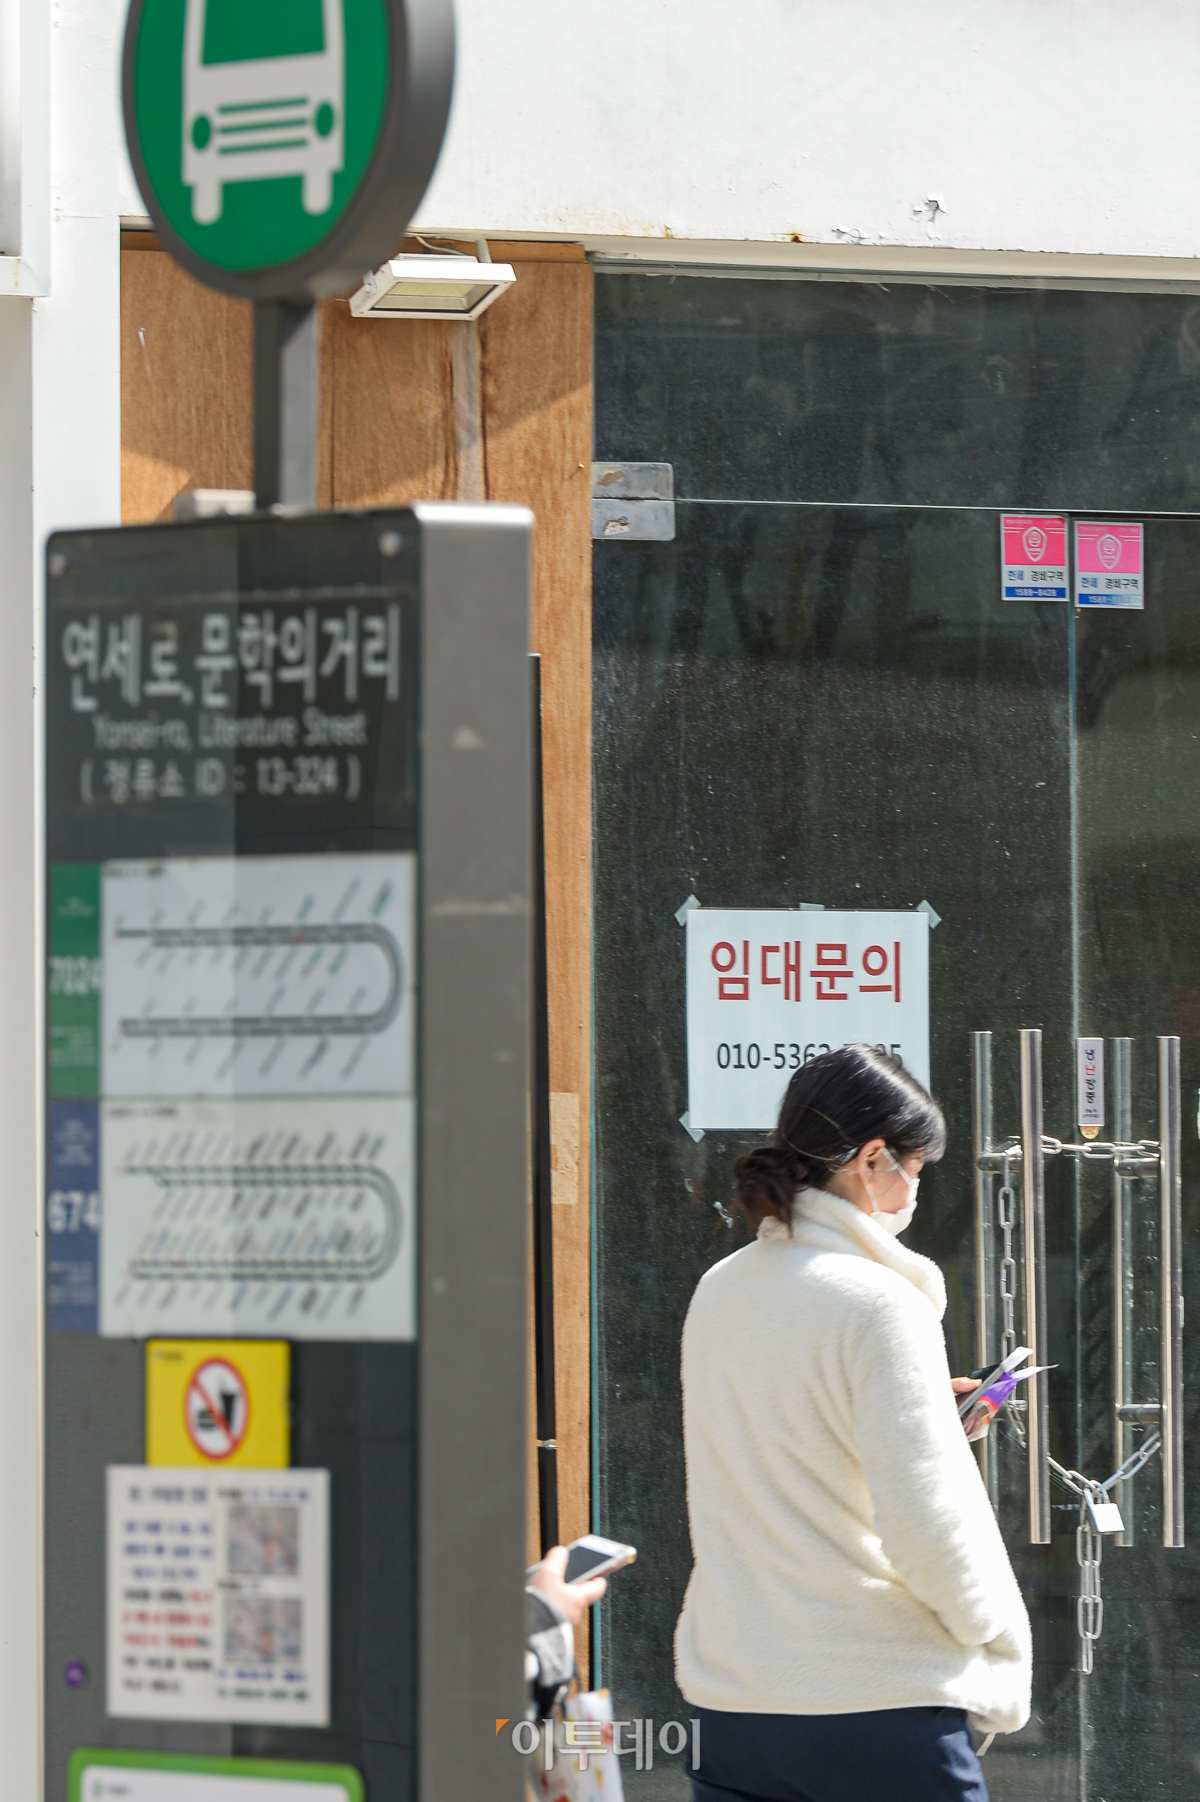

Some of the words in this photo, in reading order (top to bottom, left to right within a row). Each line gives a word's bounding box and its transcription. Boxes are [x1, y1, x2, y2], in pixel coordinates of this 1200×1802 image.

[1031, 569, 1064, 582] 경비구역
[199, 710, 296, 748] Literature
[302, 706, 367, 746] Street
[104, 757, 185, 803] 정류소
[711, 940, 901, 1003] 임대문의
